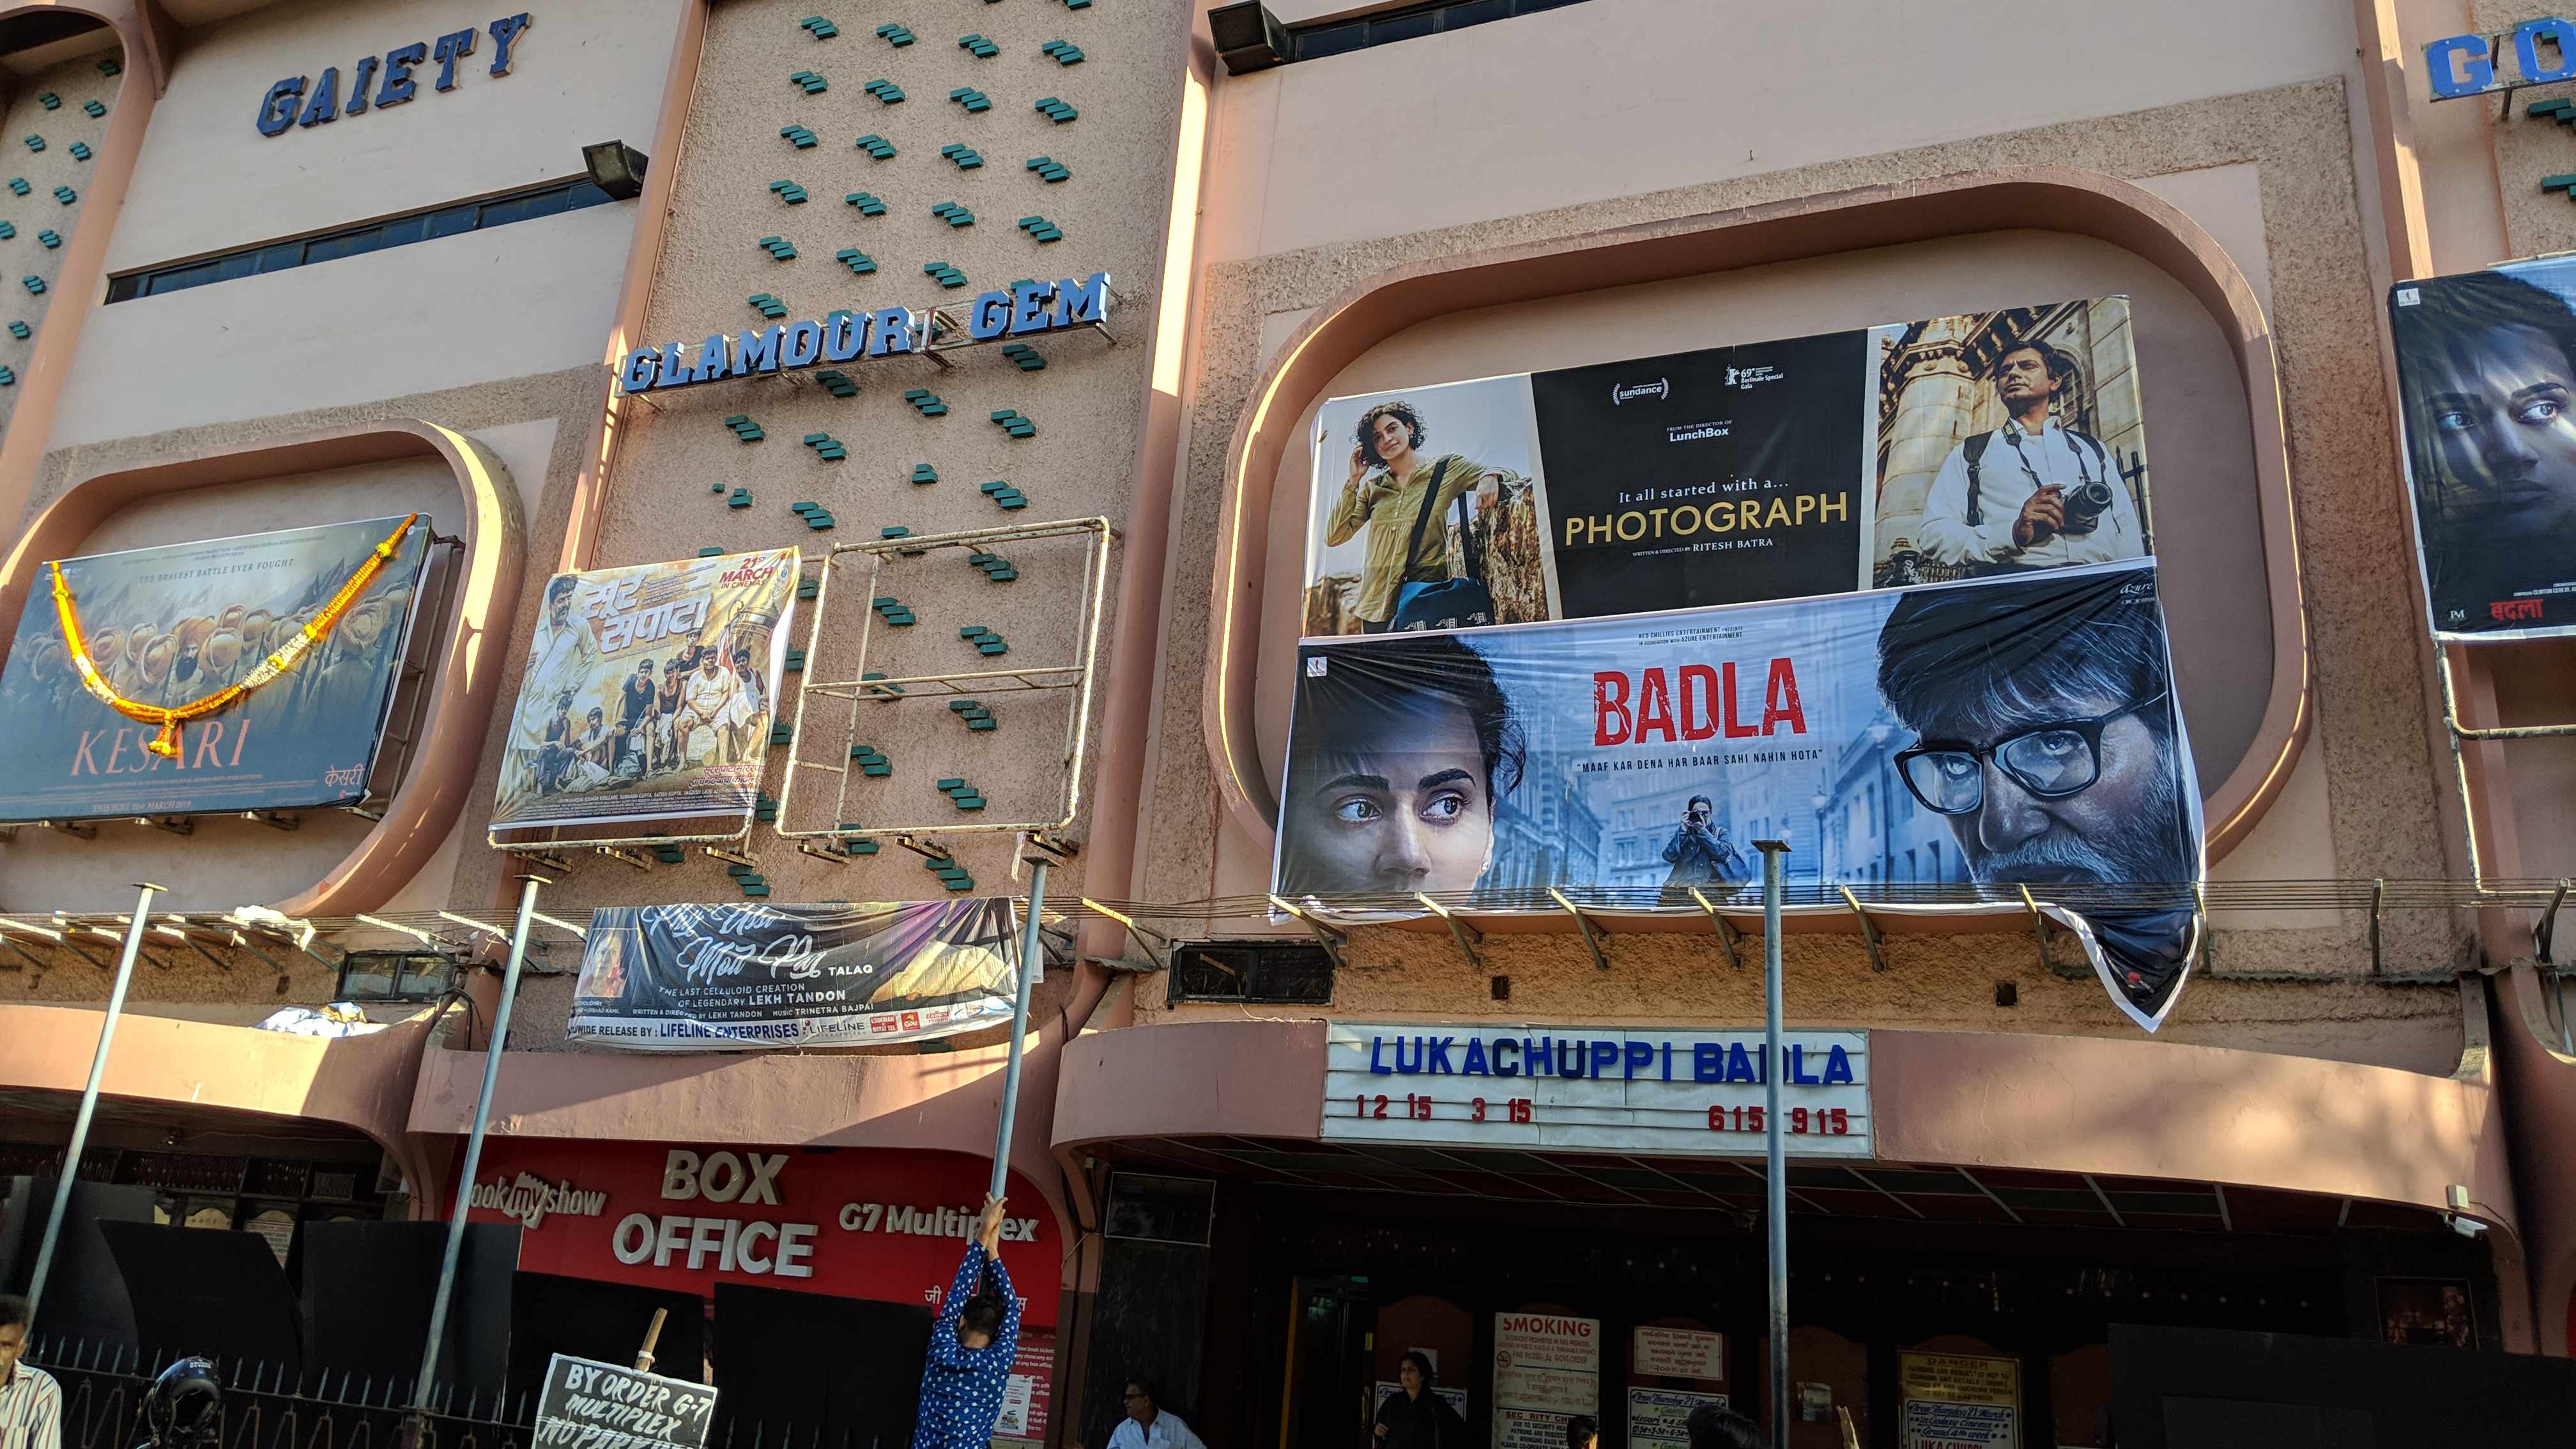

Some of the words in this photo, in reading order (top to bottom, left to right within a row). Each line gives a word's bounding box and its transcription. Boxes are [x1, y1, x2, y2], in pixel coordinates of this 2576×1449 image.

[257, 12, 533, 138] GAIETY
[621, 305, 916, 394] GLAMOUR
[969, 271, 1112, 341] GEM
[1765, 372, 1784, 381] Special
[1620, 386, 1662, 397] sundance
[1669, 427, 1729, 441] LunchBox
[1620, 491, 1630, 503] It
[1636, 489, 1655, 502] all
[1660, 481, 1715, 499] started
[1722, 478, 1758, 492] with
[1763, 479, 1789, 490] a...
[1565, 491, 1847, 546] PHOTOGRAPH
[1693, 541, 1733, 552] RITESH
[1737, 538, 1773, 548] BATRA
[157, 570, 194, 583] BRAVEST
[196, 566, 228, 578] BATTLE
[231, 562, 254, 573] EVER
[257, 558, 295, 570] FOUGHT
[719, 566, 774, 583] MARCH
[732, 579, 765, 588] CINEMAS
[582, 574, 647, 620] सूर
[2489, 598, 2543, 622] बदला
[599, 592, 714, 654] सपाटा
[1676, 627, 1720, 636] ENTERTAINMENT
[1699, 632, 1743, 641] ENTERTAINMENT
[1593, 657, 1808, 747] BADLA
[70, 719, 251, 776] KESARI
[1613, 760, 1633, 771] KAR
[1637, 758, 1664, 769] DENA
[1667, 757, 1687, 767] HAR
[1692, 755, 1719, 766] BAAR
[1724, 753, 1749, 765] SAHI
[1753, 751, 1786, 763] NAHIN
[325, 763, 365, 787] केसरी
[146, 802, 175, 810] MARCH
[827, 964, 873, 976] TALAQ
[659, 986, 677, 997] THE
[679, 988, 701, 997] LAST
[703, 986, 752, 996] CELLULOID
[755, 983, 805, 994] CREATION
[677, 999, 691, 1009] OF
[693, 997, 745, 1008] LEGENDARY
[748, 993, 782, 1006] LEKH
[786, 990, 846, 1004] TANDON
[665, 1009, 697, 1020] DIRECTED
[730, 1010, 763, 1019] TANDON
[795, 1006, 839, 1016] TRINETRA
[841, 1004, 874, 1012] BAJPAI
[599, 1025, 638, 1036] RELEASE
[640, 1027, 653, 1037] BY
[660, 1023, 711, 1038] LIFELINE
[715, 1023, 799, 1039] ENTERPRISES
[1369, 1035, 1671, 1082] LUKACHUPPI
[1357, 1093, 1388, 1120] 12
[1407, 1092, 1432, 1121] 15
[1472, 1097, 1485, 1123] 3
[1508, 1098, 1531, 1124] 15
[661, 1149, 790, 1206] BOX
[469, 1170, 608, 1229] ookmyshow
[838, 1202, 884, 1232] G7
[885, 1204, 1039, 1246] Multipex
[612, 1213, 819, 1277] OFFICE
[924, 1285, 942, 1305] जी
[1503, 1317, 1591, 1337] SMOKING
[565, 1363, 603, 1393] BY
[601, 1374, 671, 1413] ORDER
[565, 1393, 682, 1442] MULTIPLEX
[538, 1416, 577, 1446] NO
